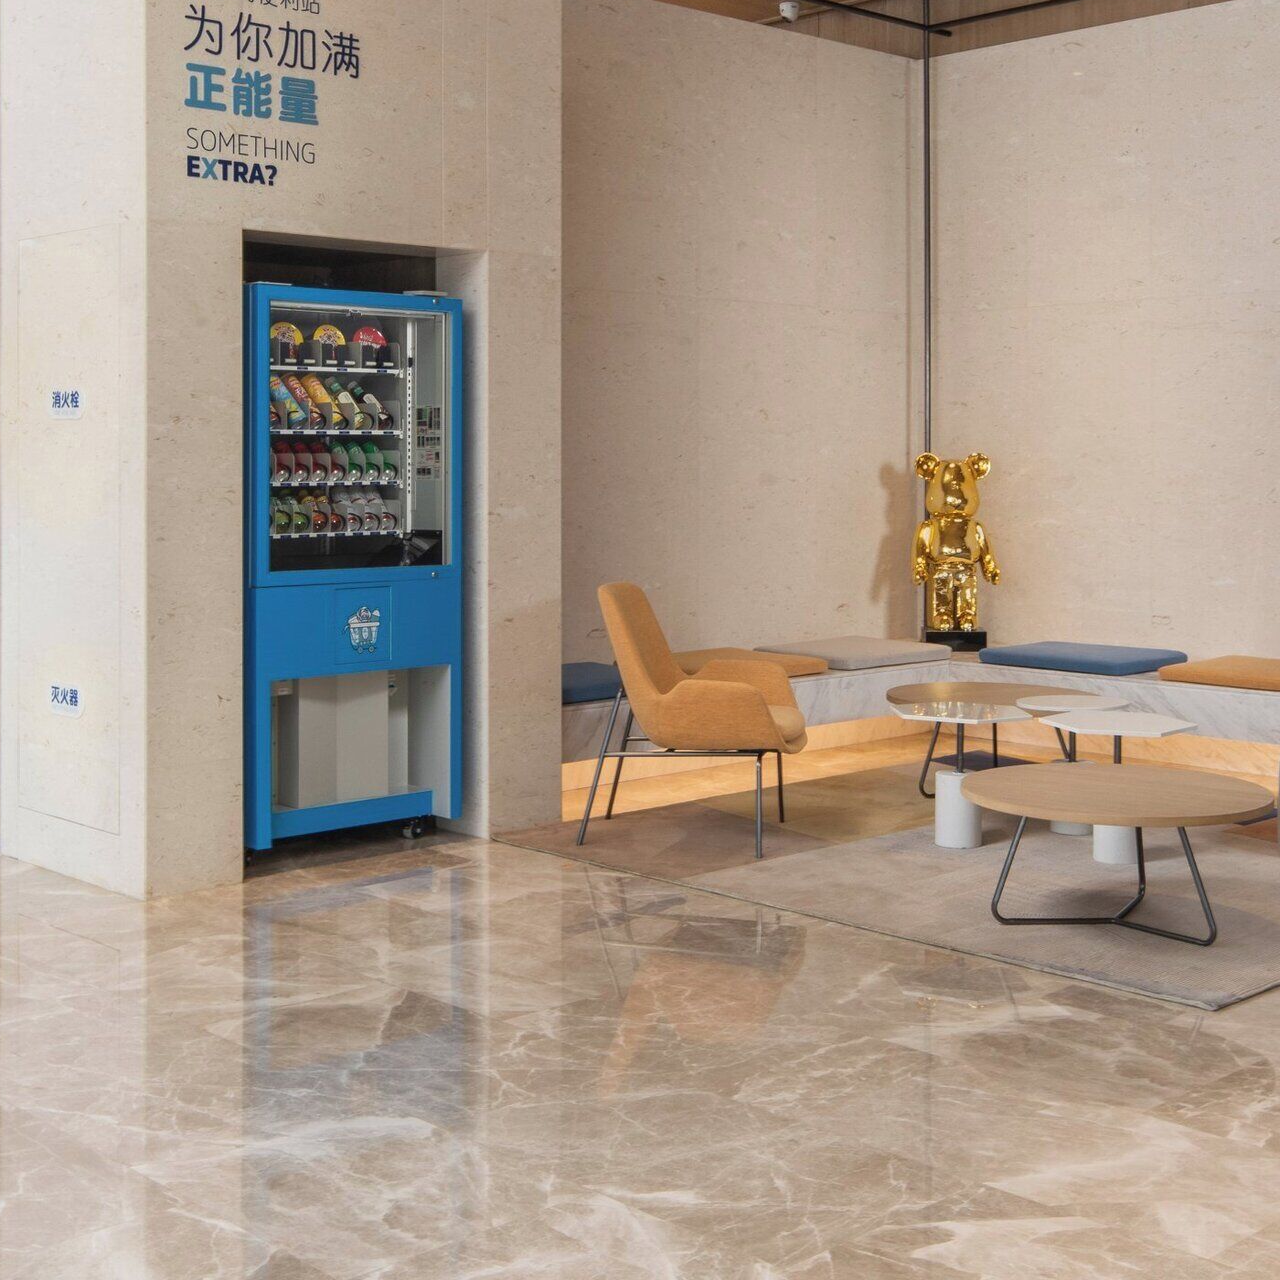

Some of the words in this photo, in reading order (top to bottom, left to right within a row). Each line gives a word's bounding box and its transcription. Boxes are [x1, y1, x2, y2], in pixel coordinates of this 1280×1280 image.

[184, 4, 361, 79] 为你加满
[184, 62, 320, 126] 正能量
[186, 127, 316, 164] SOMETHING
[186, 155, 278, 186] EXTRA?
[51, 390, 80, 409] 消火栓
[51, 685, 78, 707] 灭火器
